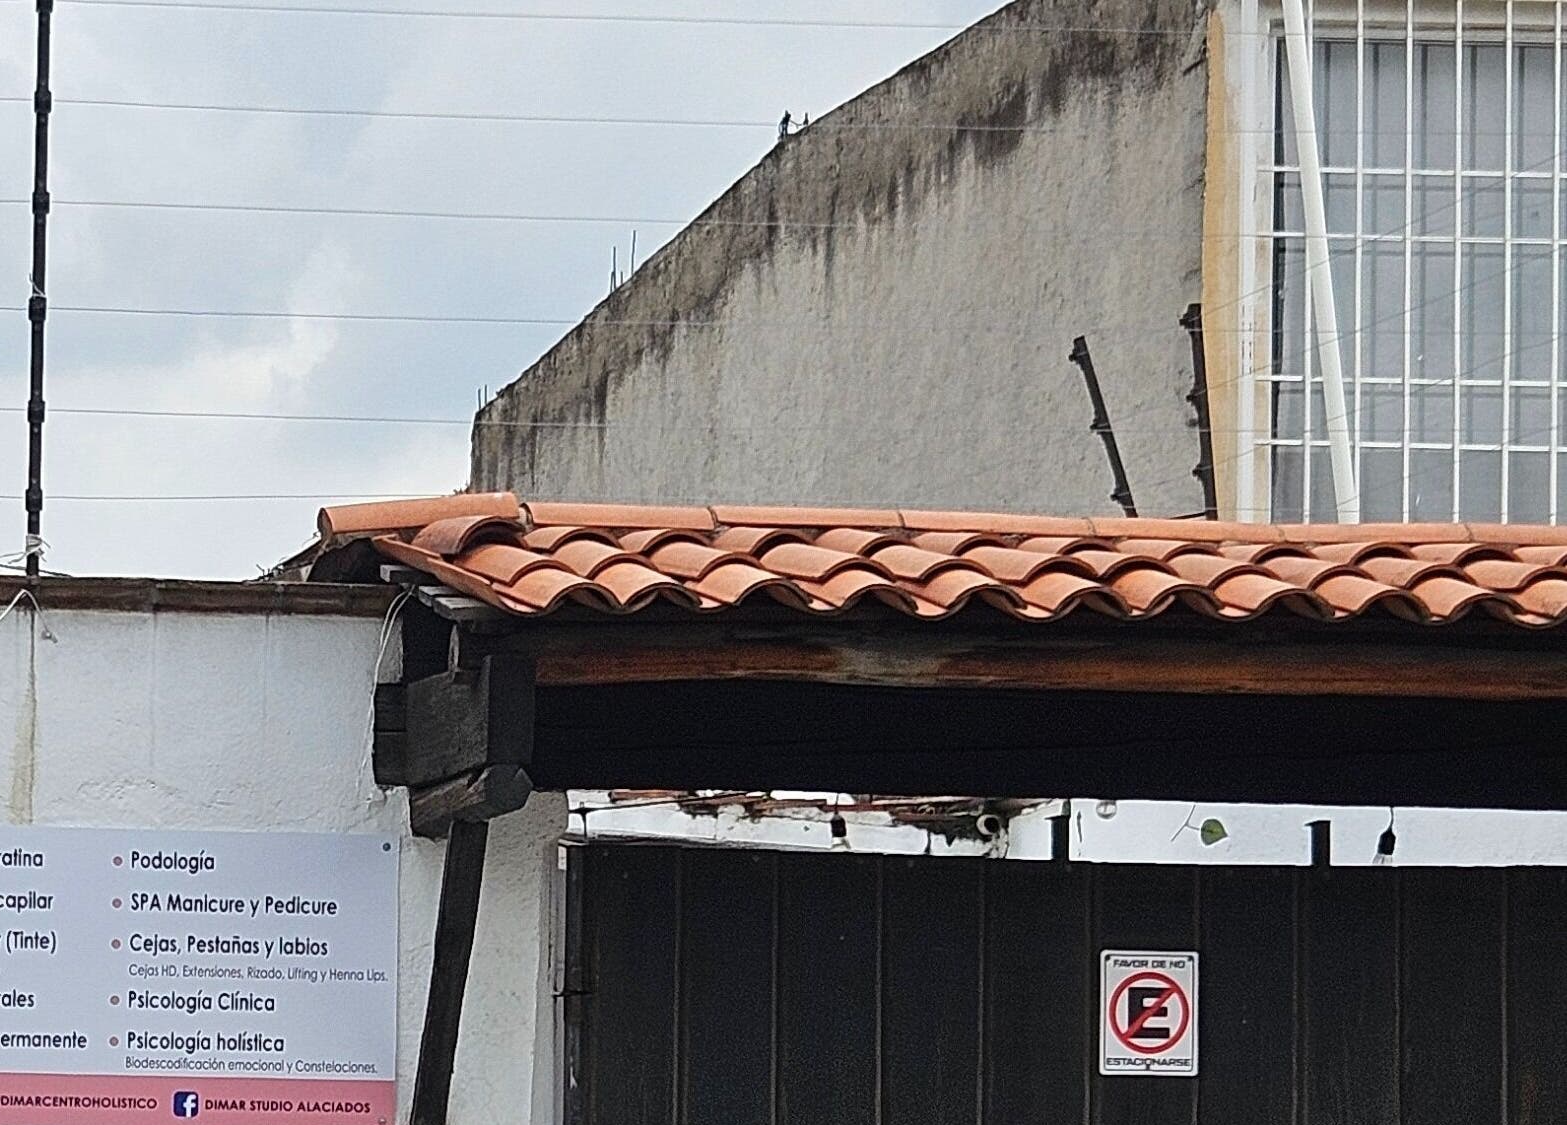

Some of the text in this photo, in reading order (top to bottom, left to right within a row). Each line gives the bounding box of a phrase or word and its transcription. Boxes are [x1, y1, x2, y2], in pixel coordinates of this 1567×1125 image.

[130, 850, 215, 874] Podología
[130, 893, 338, 917] SPA Manicure y Pedicure
[6, 930, 57, 954] (Tinte)
[129, 933, 328, 959] Cejas, Pestañas y labios
[128, 963, 389, 983] Cejas HD, Extensiones, Rizado, Lifting y Henna Lips.
[1113, 959, 1186, 969] FAVOR DE NO
[127, 989, 275, 1014] Psicología Clínica
[127, 1030, 284, 1055] Psicología holística
[125, 1056, 378, 1074] Biodescodificación emocional y Constelaciones.
[1106, 1057, 1191, 1067] ESTACIONARSE
[205, 1099, 371, 1114] DIMAR STUDIO ALACIADOS
